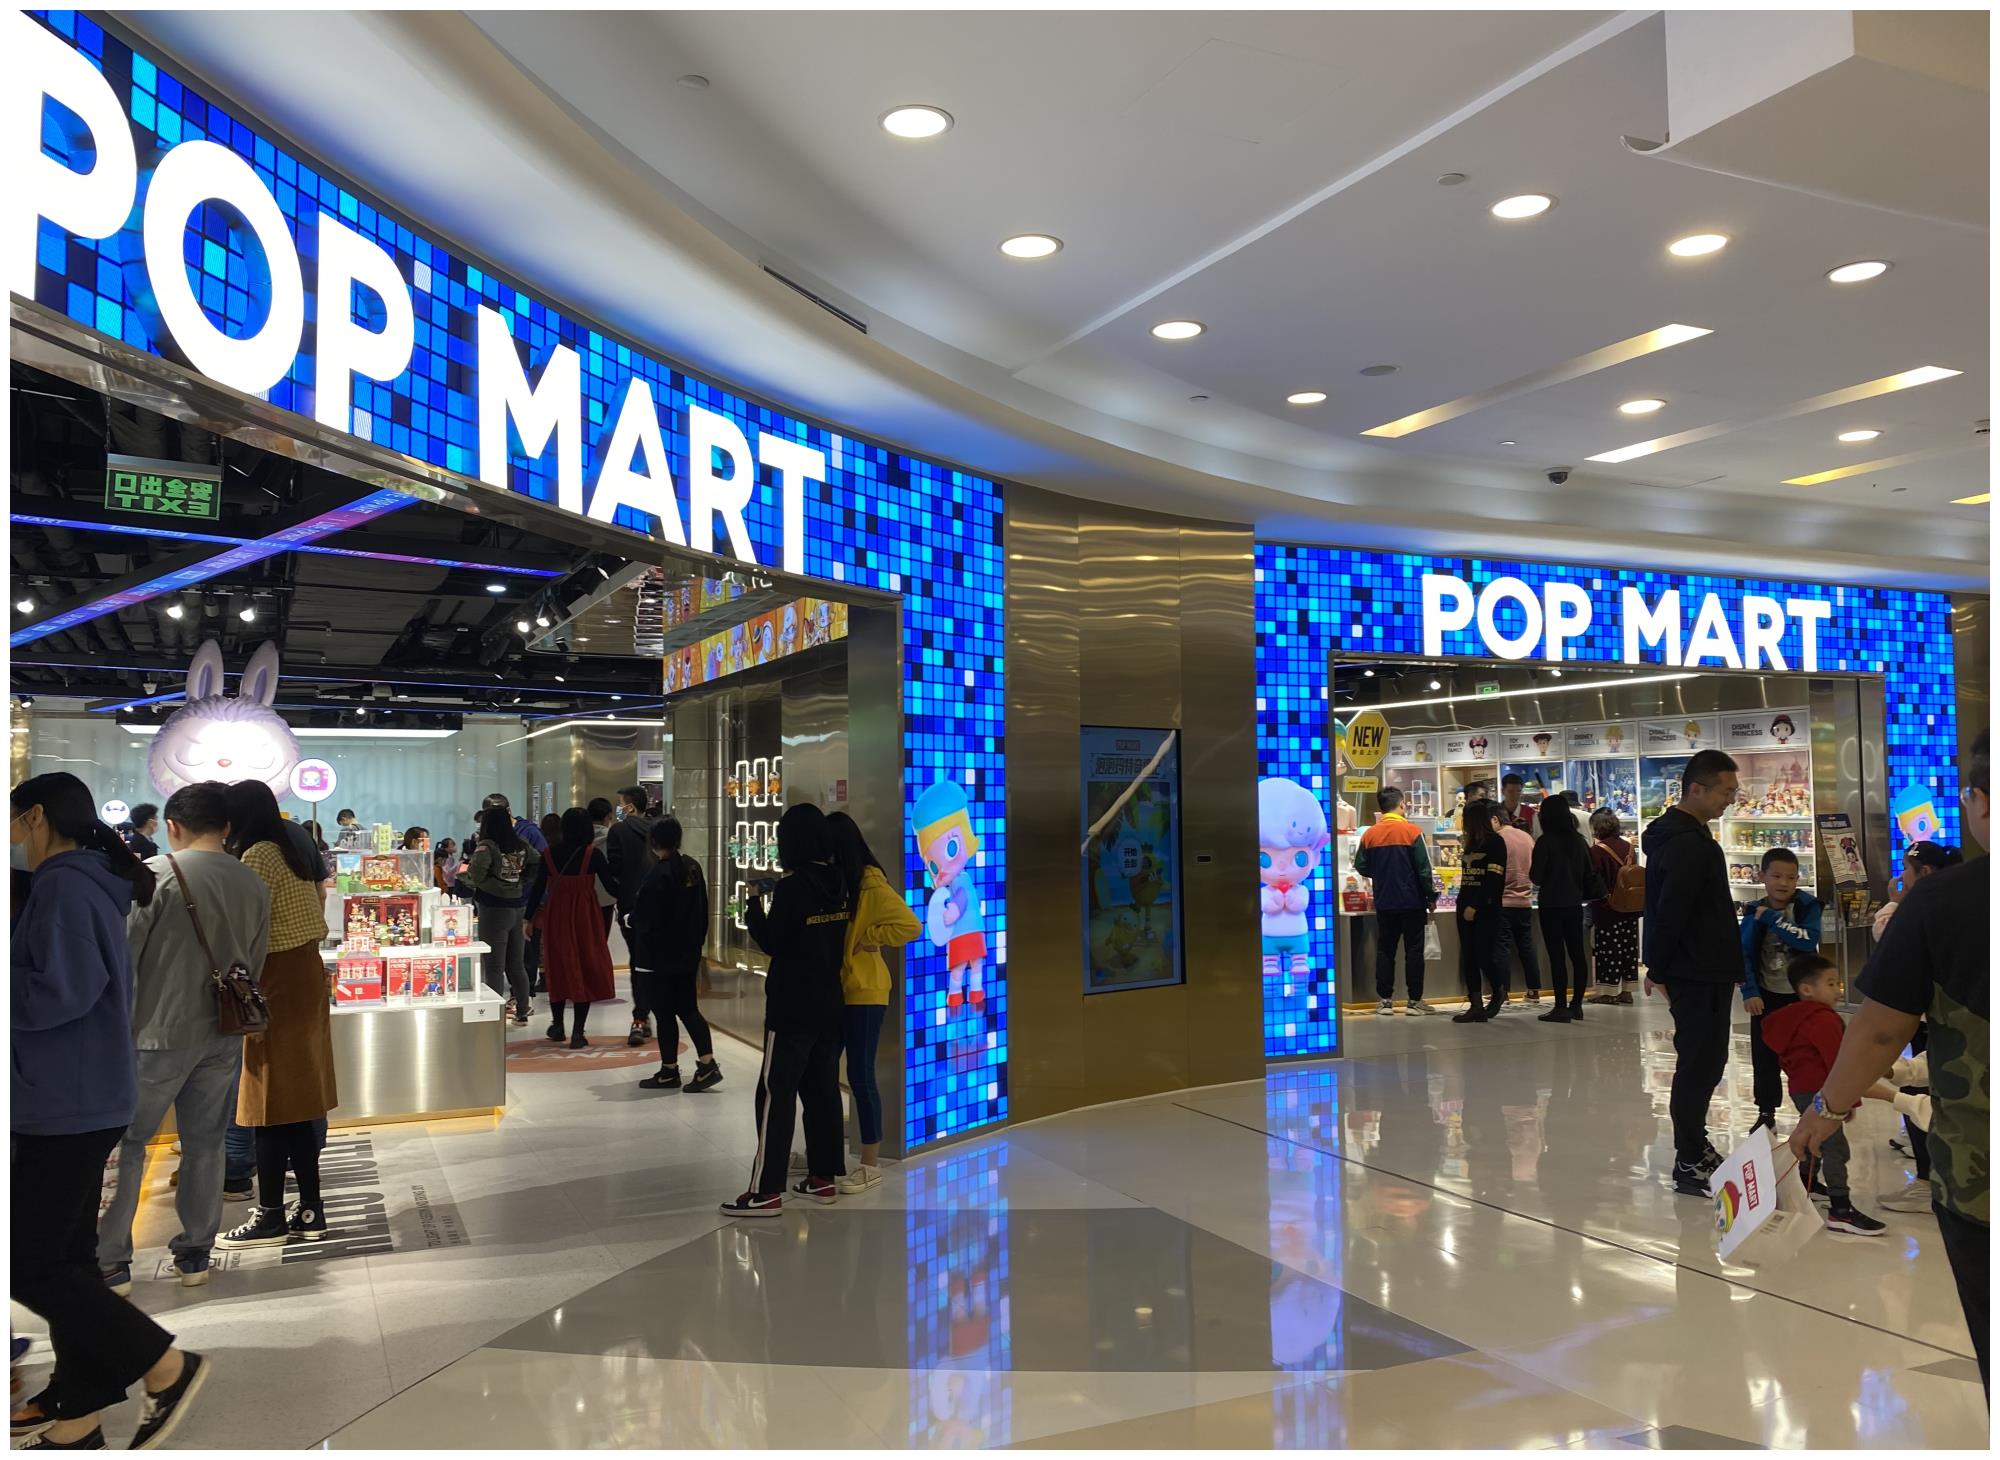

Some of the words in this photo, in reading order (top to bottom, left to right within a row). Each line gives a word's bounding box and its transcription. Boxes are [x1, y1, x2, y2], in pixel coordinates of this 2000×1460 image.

[10, 10, 415, 436] POP
[478, 304, 826, 577] MART
[1421, 573, 1593, 661] POP
[1622, 587, 1832, 672] MART
[1352, 726, 1385, 747] NEW
[1731, 722, 1756, 731] DISNEY
[1731, 729, 1763, 738] PRINCESS
[1744, 1163, 1755, 1181] POP
[1747, 1180, 1758, 1209] MART
